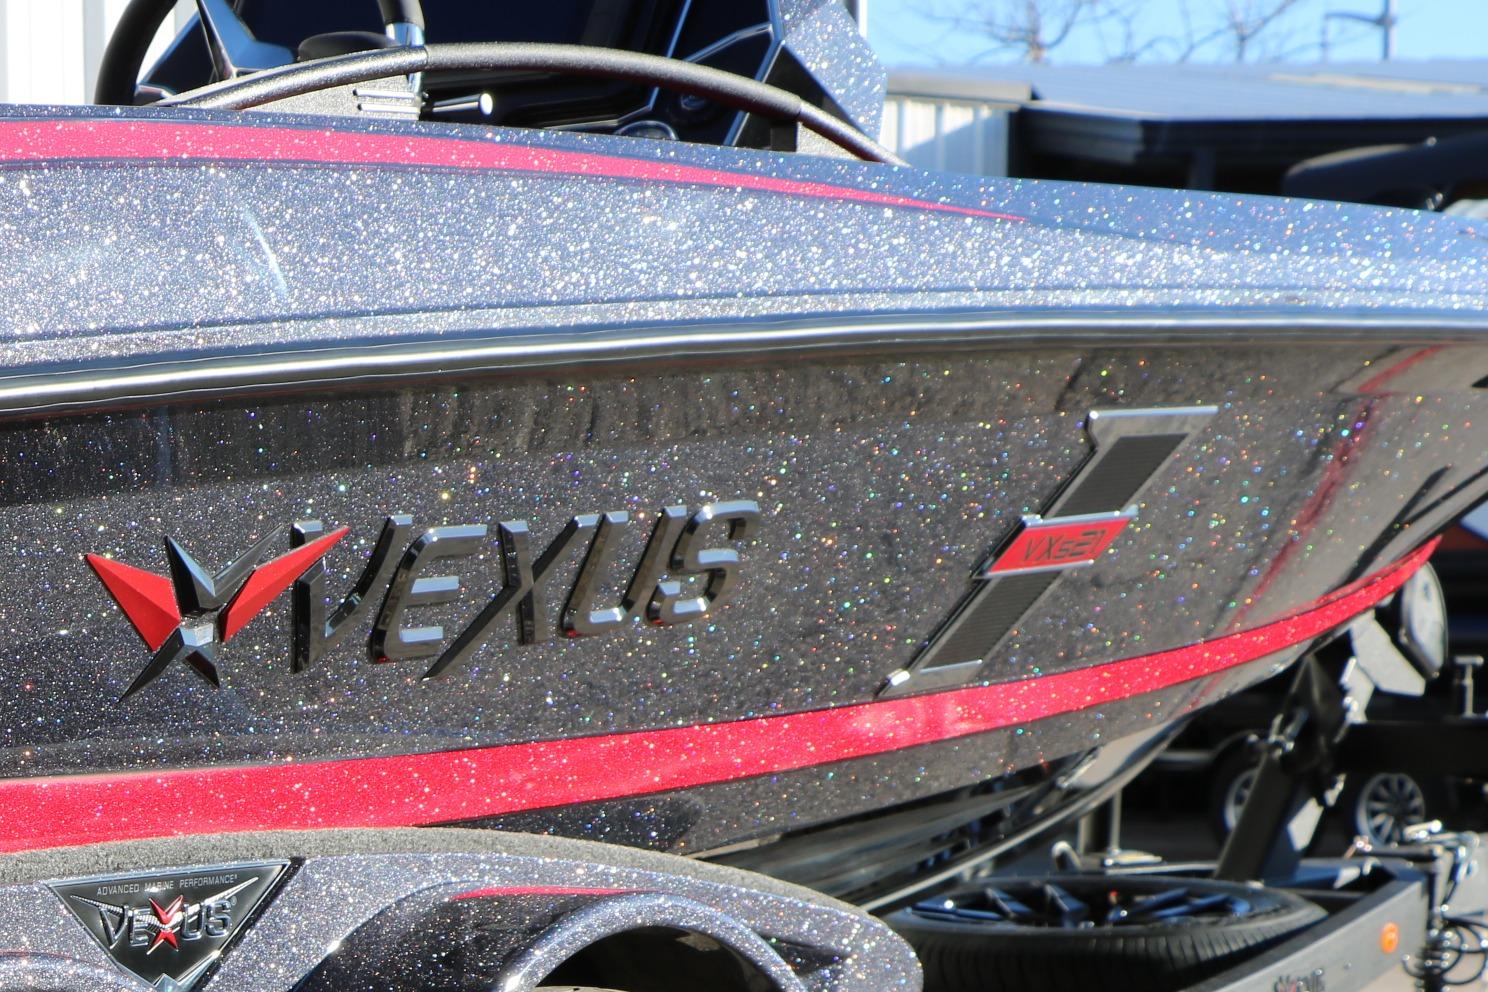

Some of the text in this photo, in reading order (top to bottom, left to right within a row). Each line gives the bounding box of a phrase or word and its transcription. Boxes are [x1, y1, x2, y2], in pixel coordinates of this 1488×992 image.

[291, 500, 761, 680] VEXUS
[97, 884, 140, 896] ADVANCED
[145, 880, 174, 892] MARINE
[97, 895, 234, 955] VEXUS
